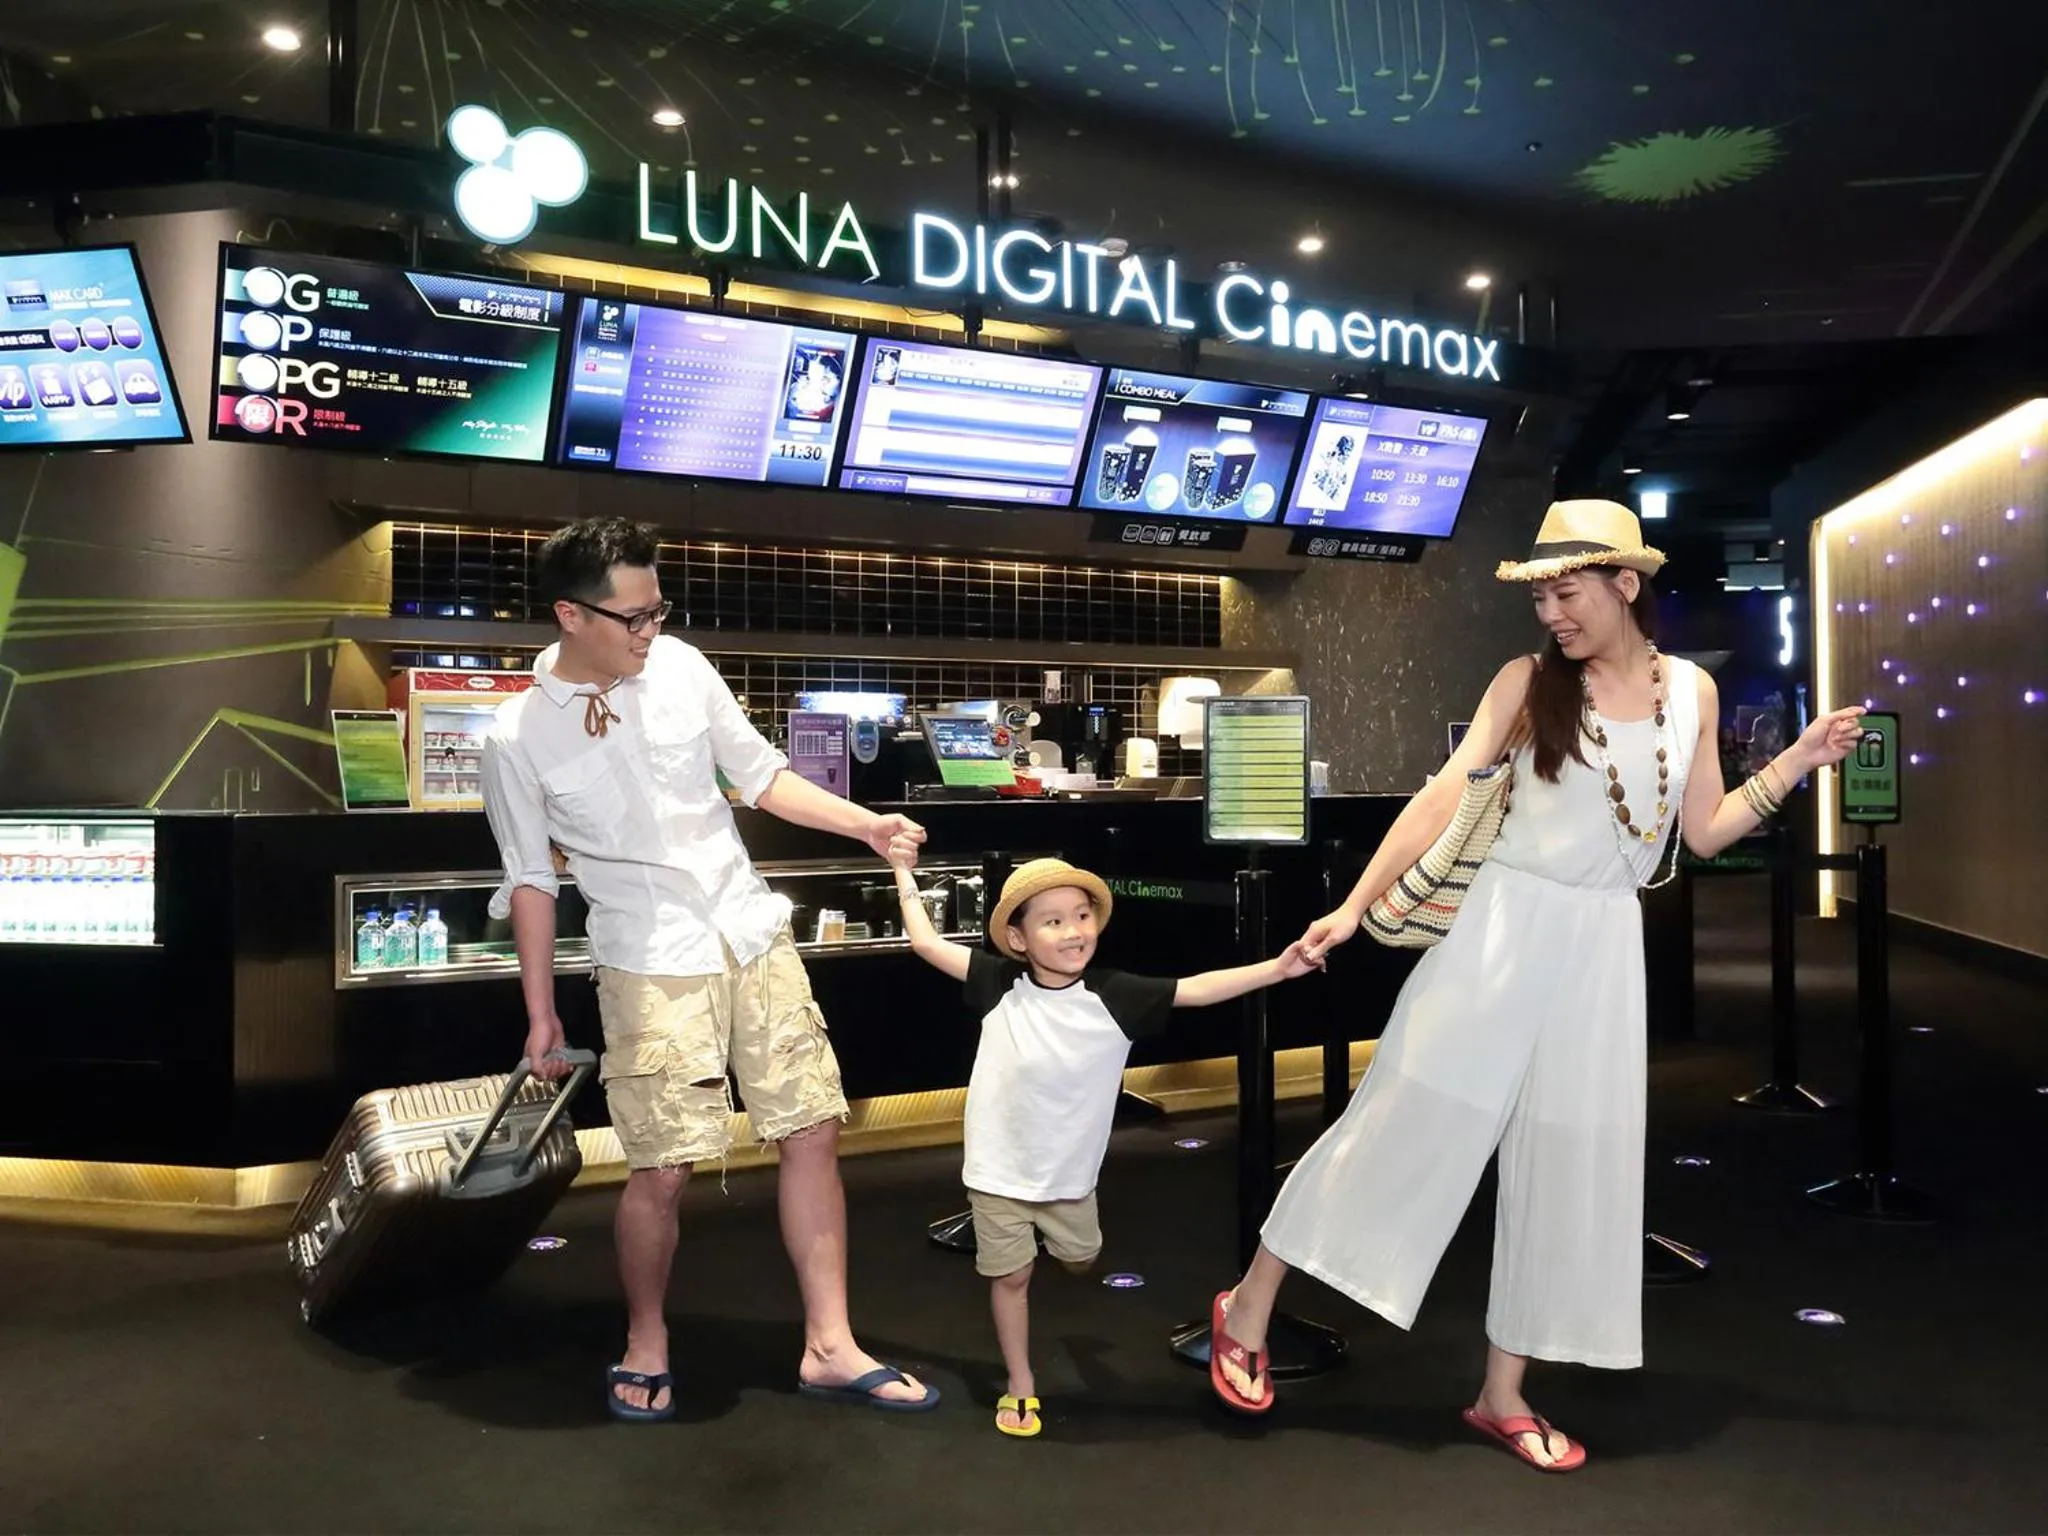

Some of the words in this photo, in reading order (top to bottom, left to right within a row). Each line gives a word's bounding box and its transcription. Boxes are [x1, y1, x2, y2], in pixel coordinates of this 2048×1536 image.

[640, 162, 881, 285] LUNA
[913, 212, 1196, 331] DIGITAL
[1216, 274, 1501, 382] Cinemax
[459, 297, 542, 321] 電影分級制度
[277, 357, 341, 400] PG
[1120, 384, 1153, 397] COMBO
[1154, 388, 1178, 400] MEAL
[275, 397, 309, 437] R
[779, 443, 823, 462] 11:30
[1128, 880, 1183, 899] Cinemax
